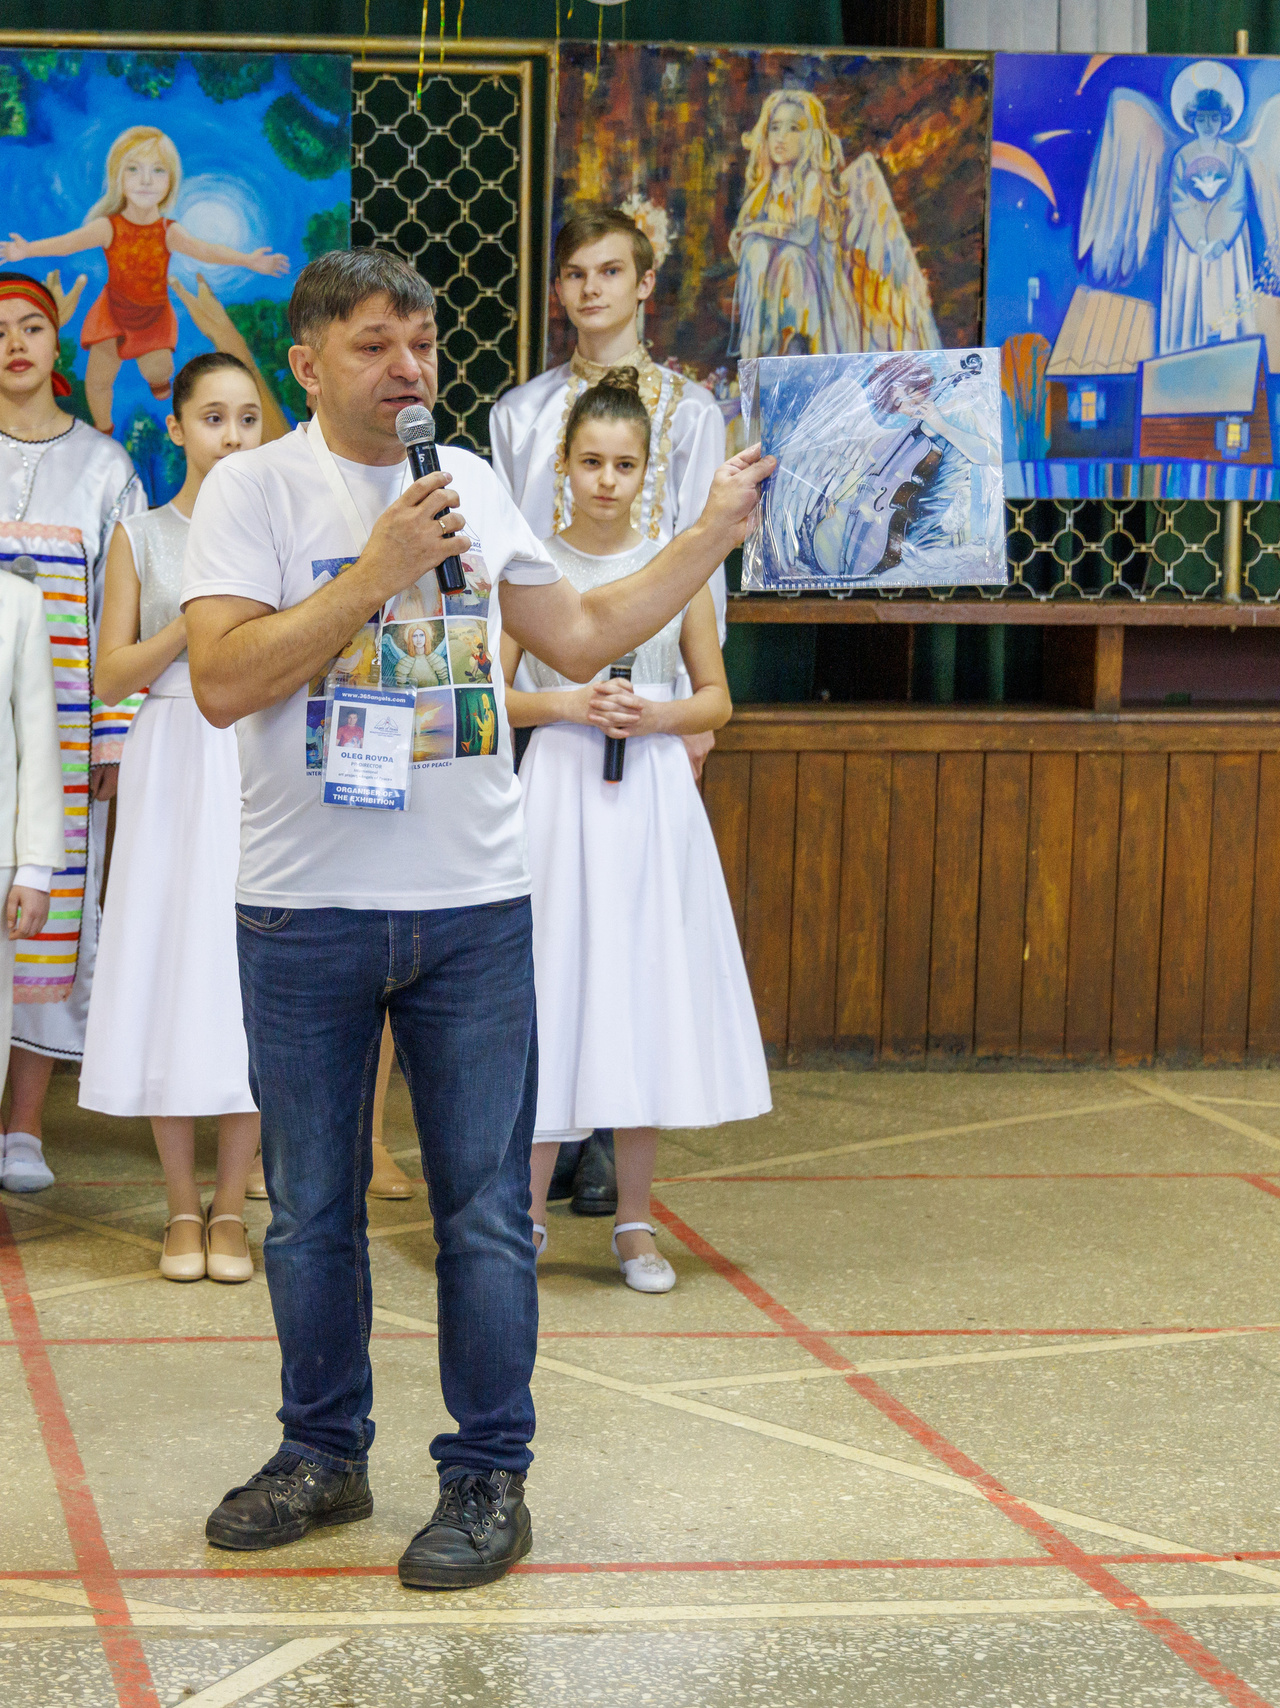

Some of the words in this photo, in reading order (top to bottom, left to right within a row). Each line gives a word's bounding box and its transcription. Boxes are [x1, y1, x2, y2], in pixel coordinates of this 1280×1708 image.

[342, 691, 406, 703] www.365angels.com
[340, 751, 363, 760] OLEG
[365, 754, 394, 763] ROVDA
[336, 785, 381, 797] ORGANISER
[382, 789, 394, 798] OF
[332, 793, 349, 802] THE
[349, 795, 395, 806] EXHIBITION
